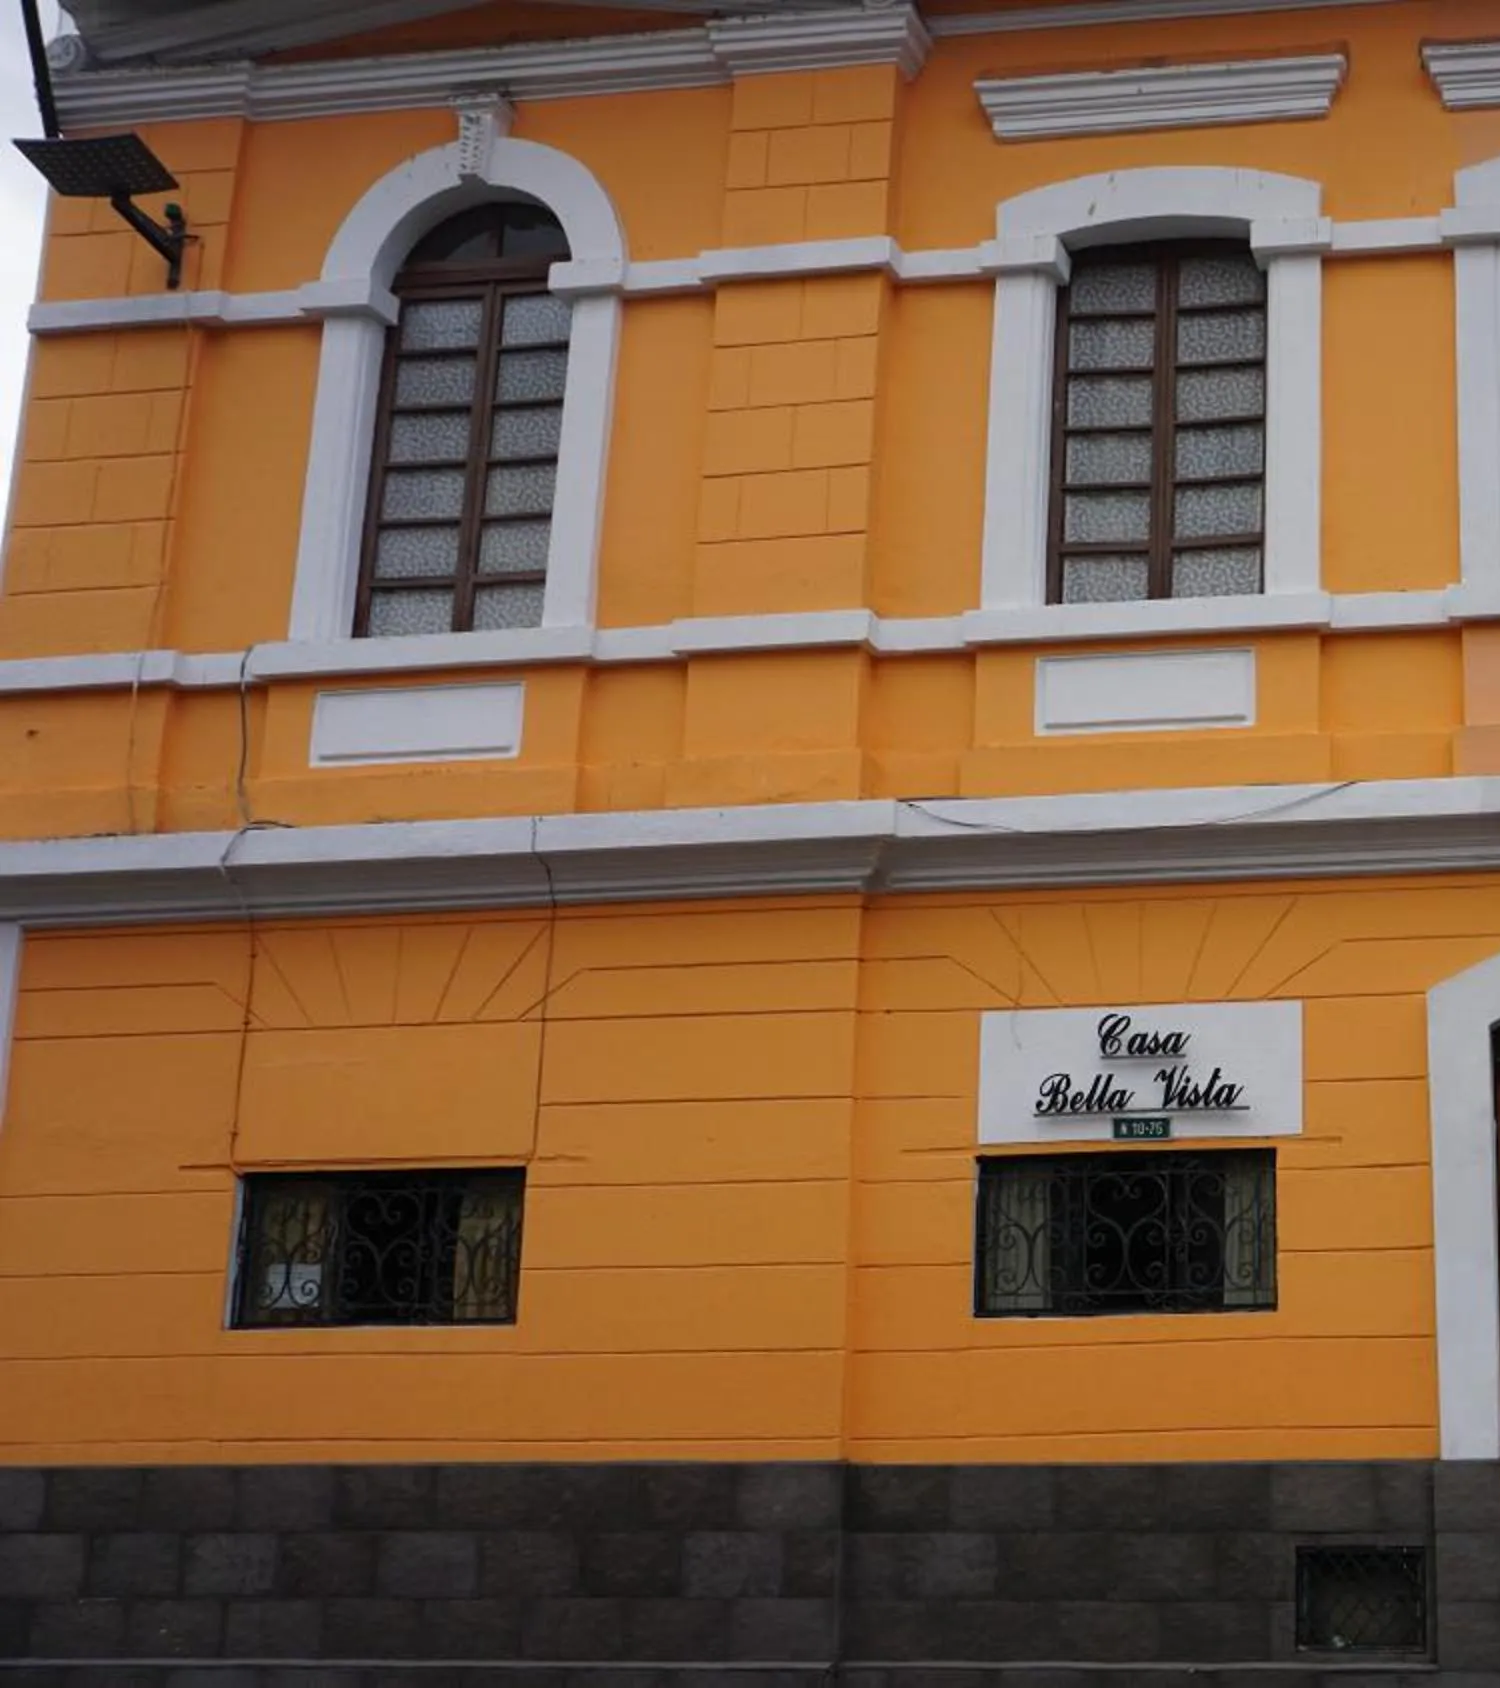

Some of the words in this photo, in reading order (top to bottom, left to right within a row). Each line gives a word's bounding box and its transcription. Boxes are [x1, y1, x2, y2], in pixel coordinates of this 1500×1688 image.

[1098, 1013, 1191, 1055] Casa
[1036, 1073, 1135, 1112] Bella
[1153, 1065, 1244, 1108] Vista
